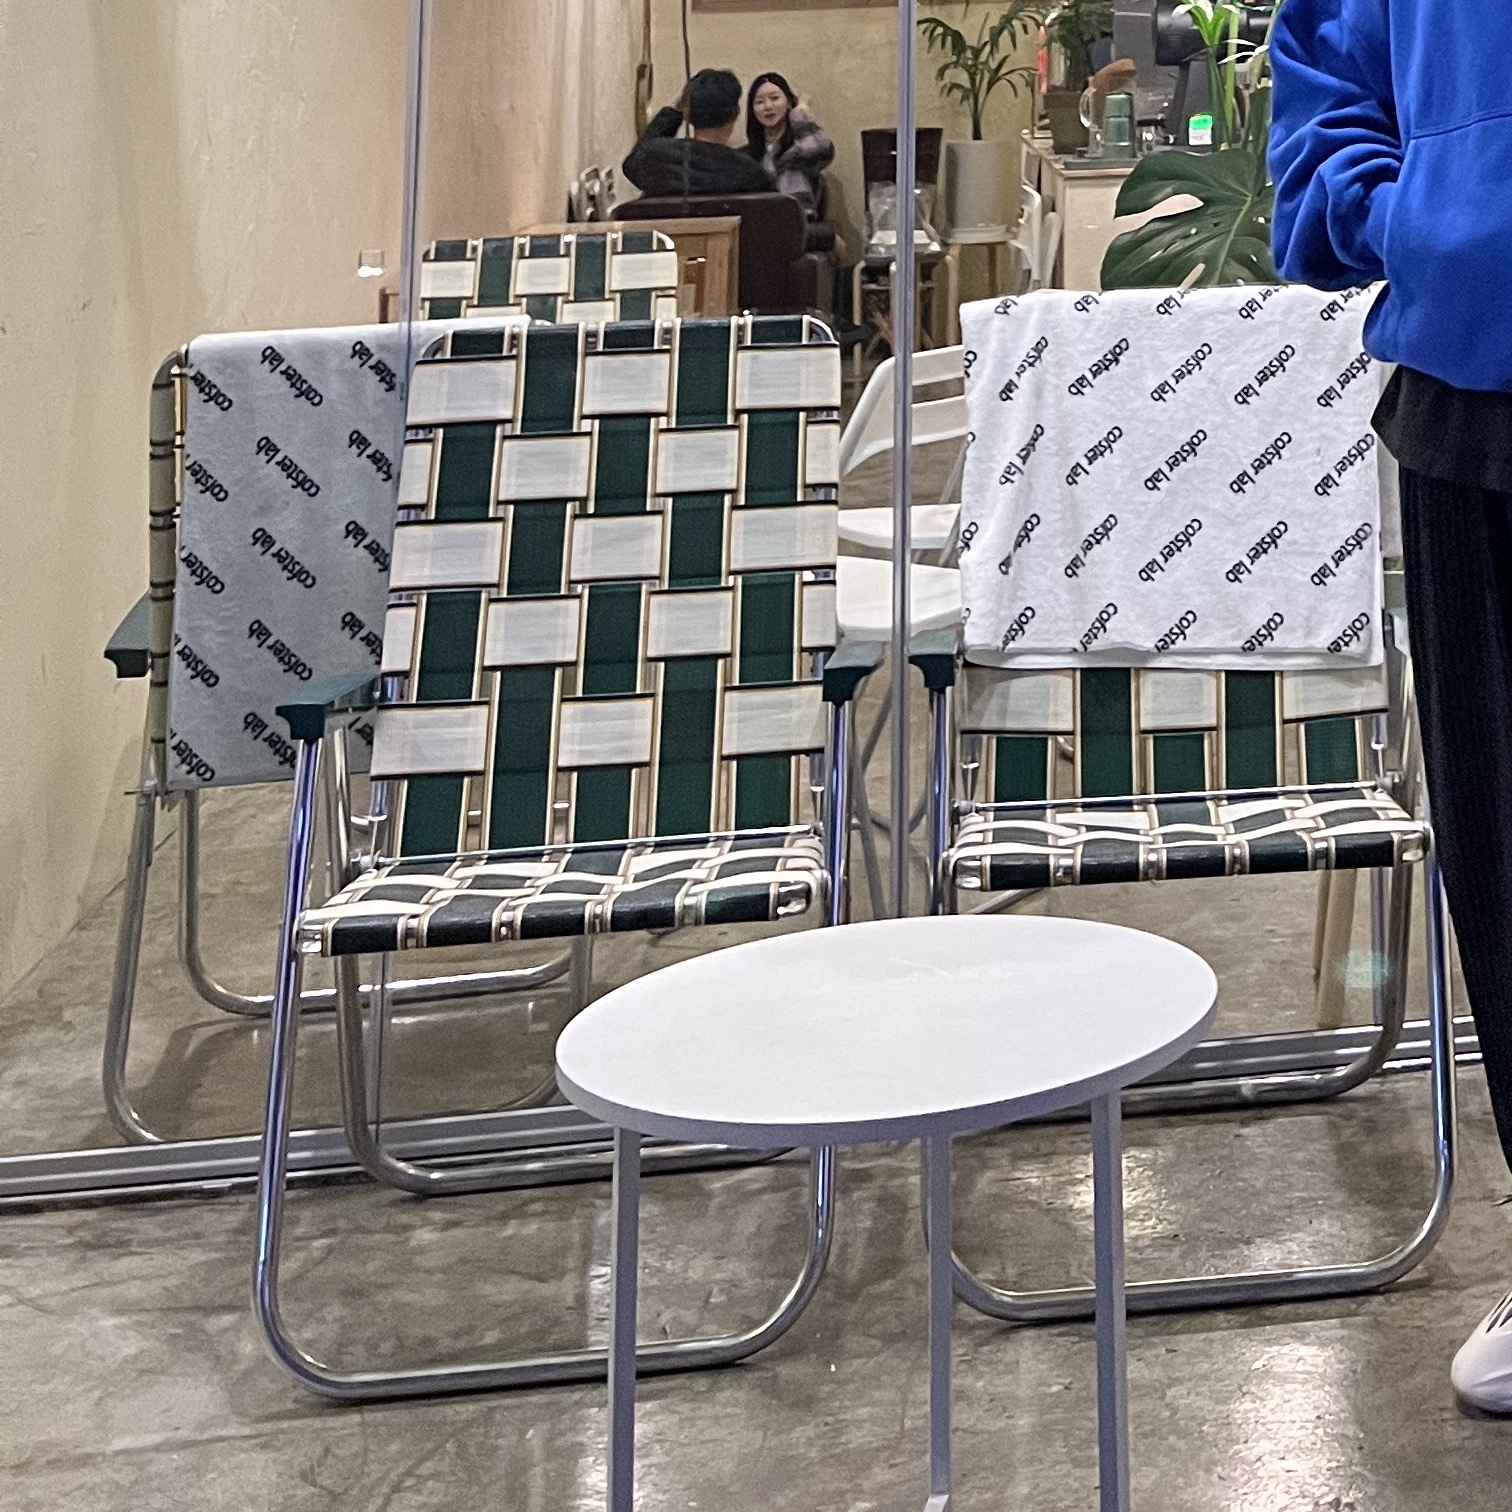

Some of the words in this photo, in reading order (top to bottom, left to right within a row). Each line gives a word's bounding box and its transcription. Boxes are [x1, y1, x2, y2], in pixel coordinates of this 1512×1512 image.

[1073, 294, 1100, 313] lab
[1156, 295, 1182, 316] lab
[1238, 297, 1264, 320] lab
[1319, 299, 1345, 322] lab
[260, 345, 285, 374] lab
[349, 340, 374, 369] lab
[1088, 337, 1130, 380] cofster
[1171, 342, 1213, 385] cofster
[1254, 344, 1296, 388] cofster
[279, 365, 324, 407] cofster
[367, 359, 397, 393] fster
[1067, 373, 1094, 396] lab
[1336, 351, 1372, 391] ofster
[189, 370, 233, 412] cofster
[998, 378, 1019, 402] lab
[1150, 380, 1177, 403] lab
[1234, 383, 1260, 405] lab
[1316, 385, 1343, 408] lab
[255, 436, 281, 465] lab
[348, 429, 372, 458] lab
[1083, 425, 1123, 466] cofster
[1164, 429, 1208, 473] cofster
[1250, 431, 1292, 476] cofster
[1333, 433, 1375, 479] cofster
[274, 454, 321, 498] cofster
[365, 449, 393, 482] fster
[998, 461, 1025, 486] lab
[1065, 461, 1090, 486] lab
[1143, 467, 1171, 491] lab
[182, 460, 229, 503] cofster
[1229, 470, 1256, 494] lab
[1314, 472, 1340, 497] lab
[251, 527, 276, 557] lab
[343, 520, 369, 549] lab
[1080, 513, 1118, 558] cofster
[1159, 518, 1203, 564] cofster
[1245, 520, 1288, 566] cofster
[1330, 522, 1372, 569] cofster
[270, 547, 317, 589] cofster
[362, 539, 391, 573] fster
[1064, 553, 1086, 579] lab
[1138, 558, 1166, 582] lab
[180, 552, 225, 595] cofster
[1225, 560, 1252, 584] lab
[1310, 562, 1337, 587] lab
[247, 619, 273, 649] lab
[341, 611, 366, 640] lab
[1079, 602, 1118, 655] cofster
[176, 644, 220, 688] cofster
[266, 639, 313, 682] cofster
[243, 712, 269, 741] lab
[171, 738, 216, 784] cofster
[262, 731, 297, 770] fster
